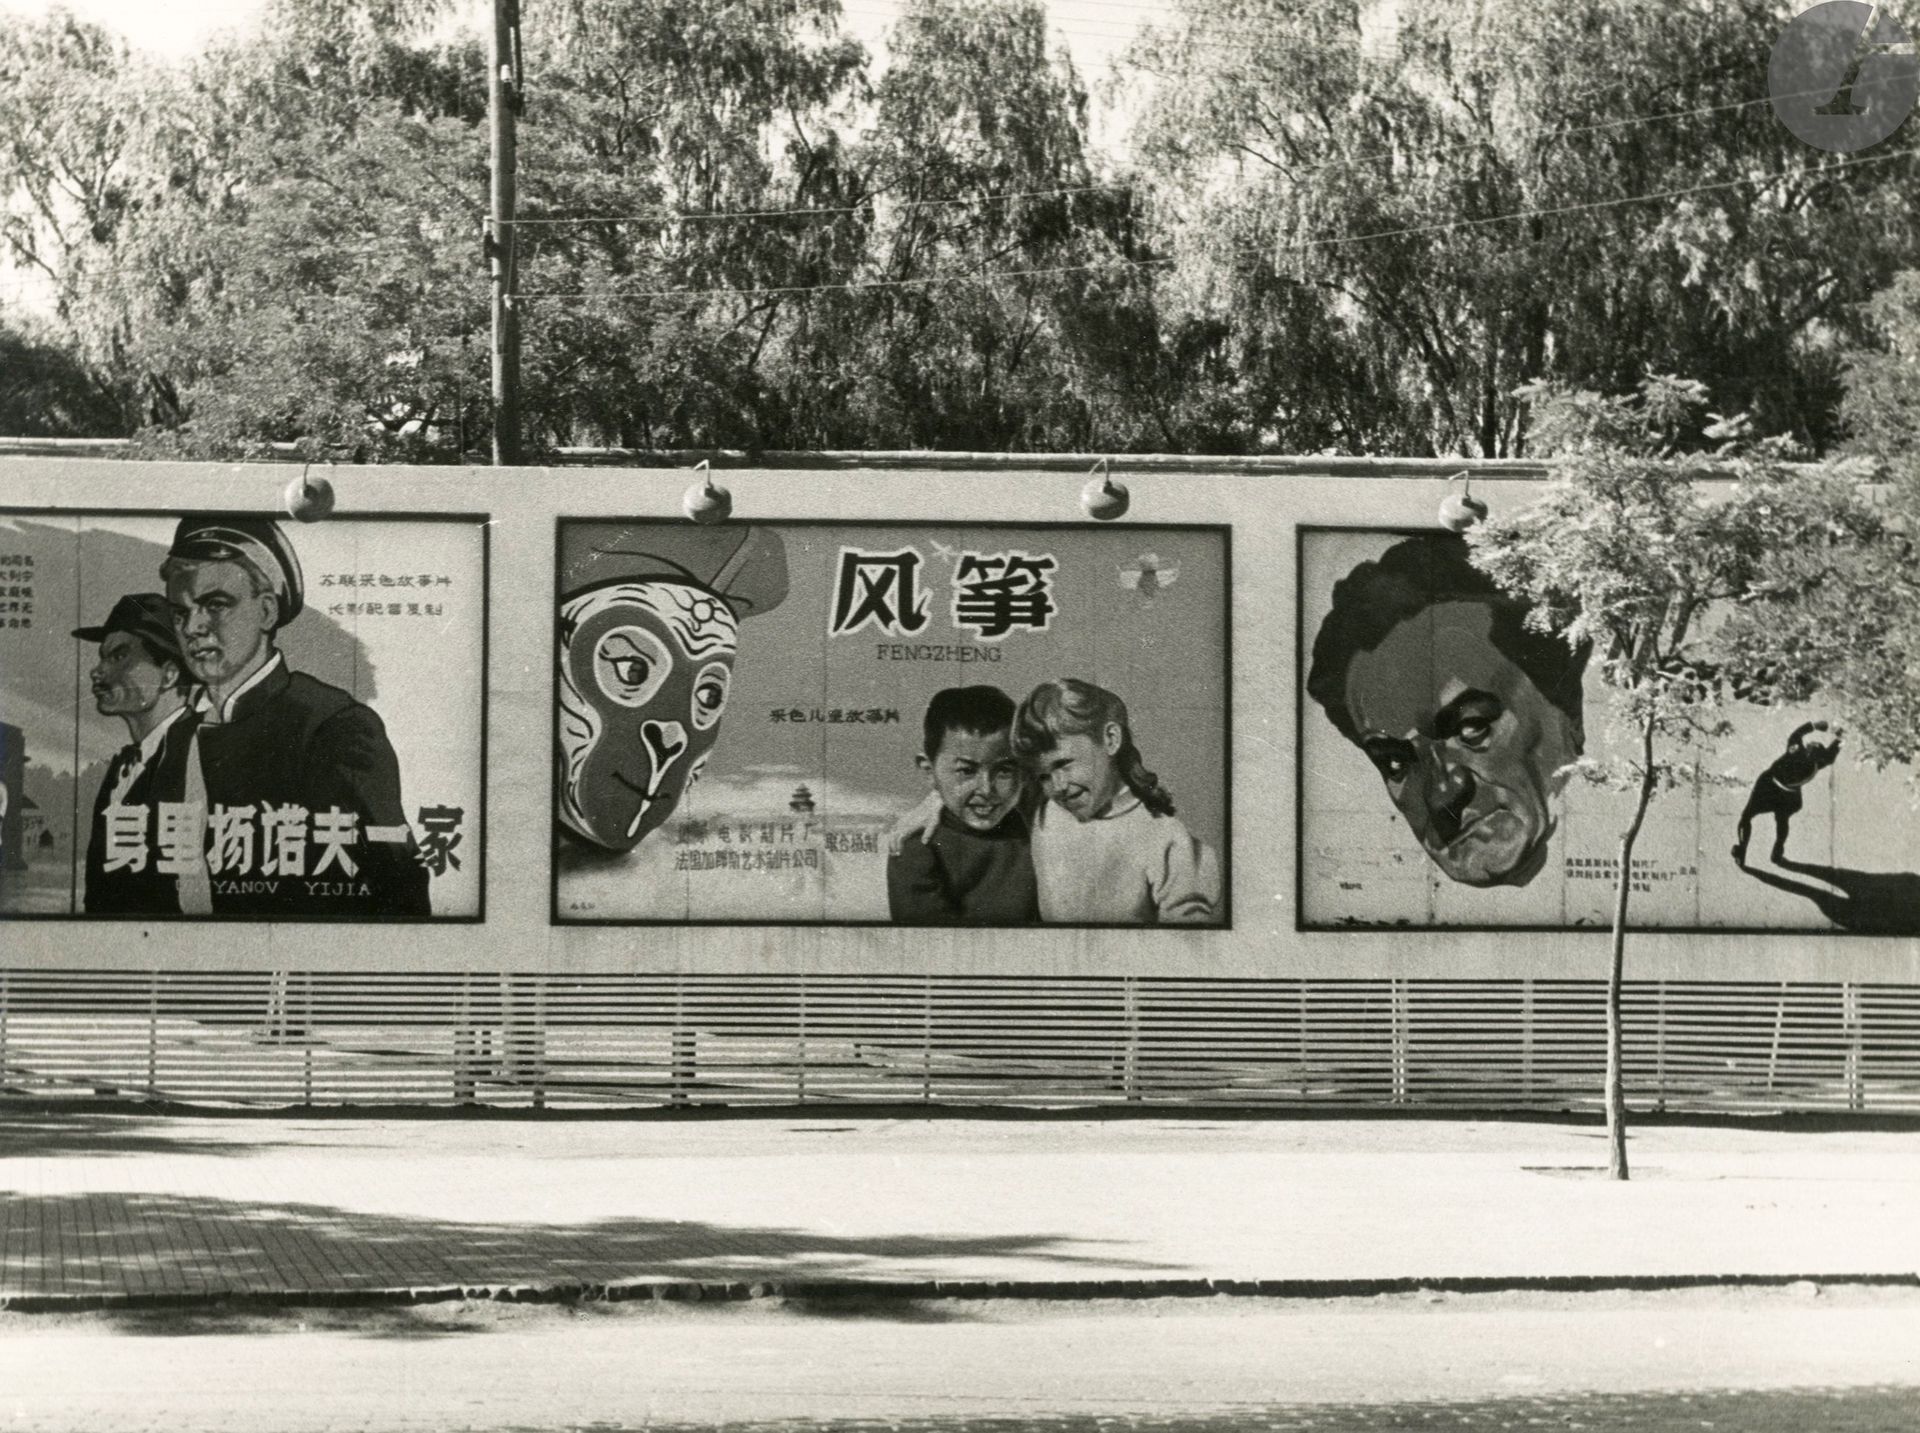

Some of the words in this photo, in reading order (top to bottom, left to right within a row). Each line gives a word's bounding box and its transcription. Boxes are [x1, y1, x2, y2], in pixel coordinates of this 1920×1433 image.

[828, 545, 1057, 642] 风筝
[876, 644, 1001, 663] FENGZHENG
[304, 881, 372, 897] YIJIA
